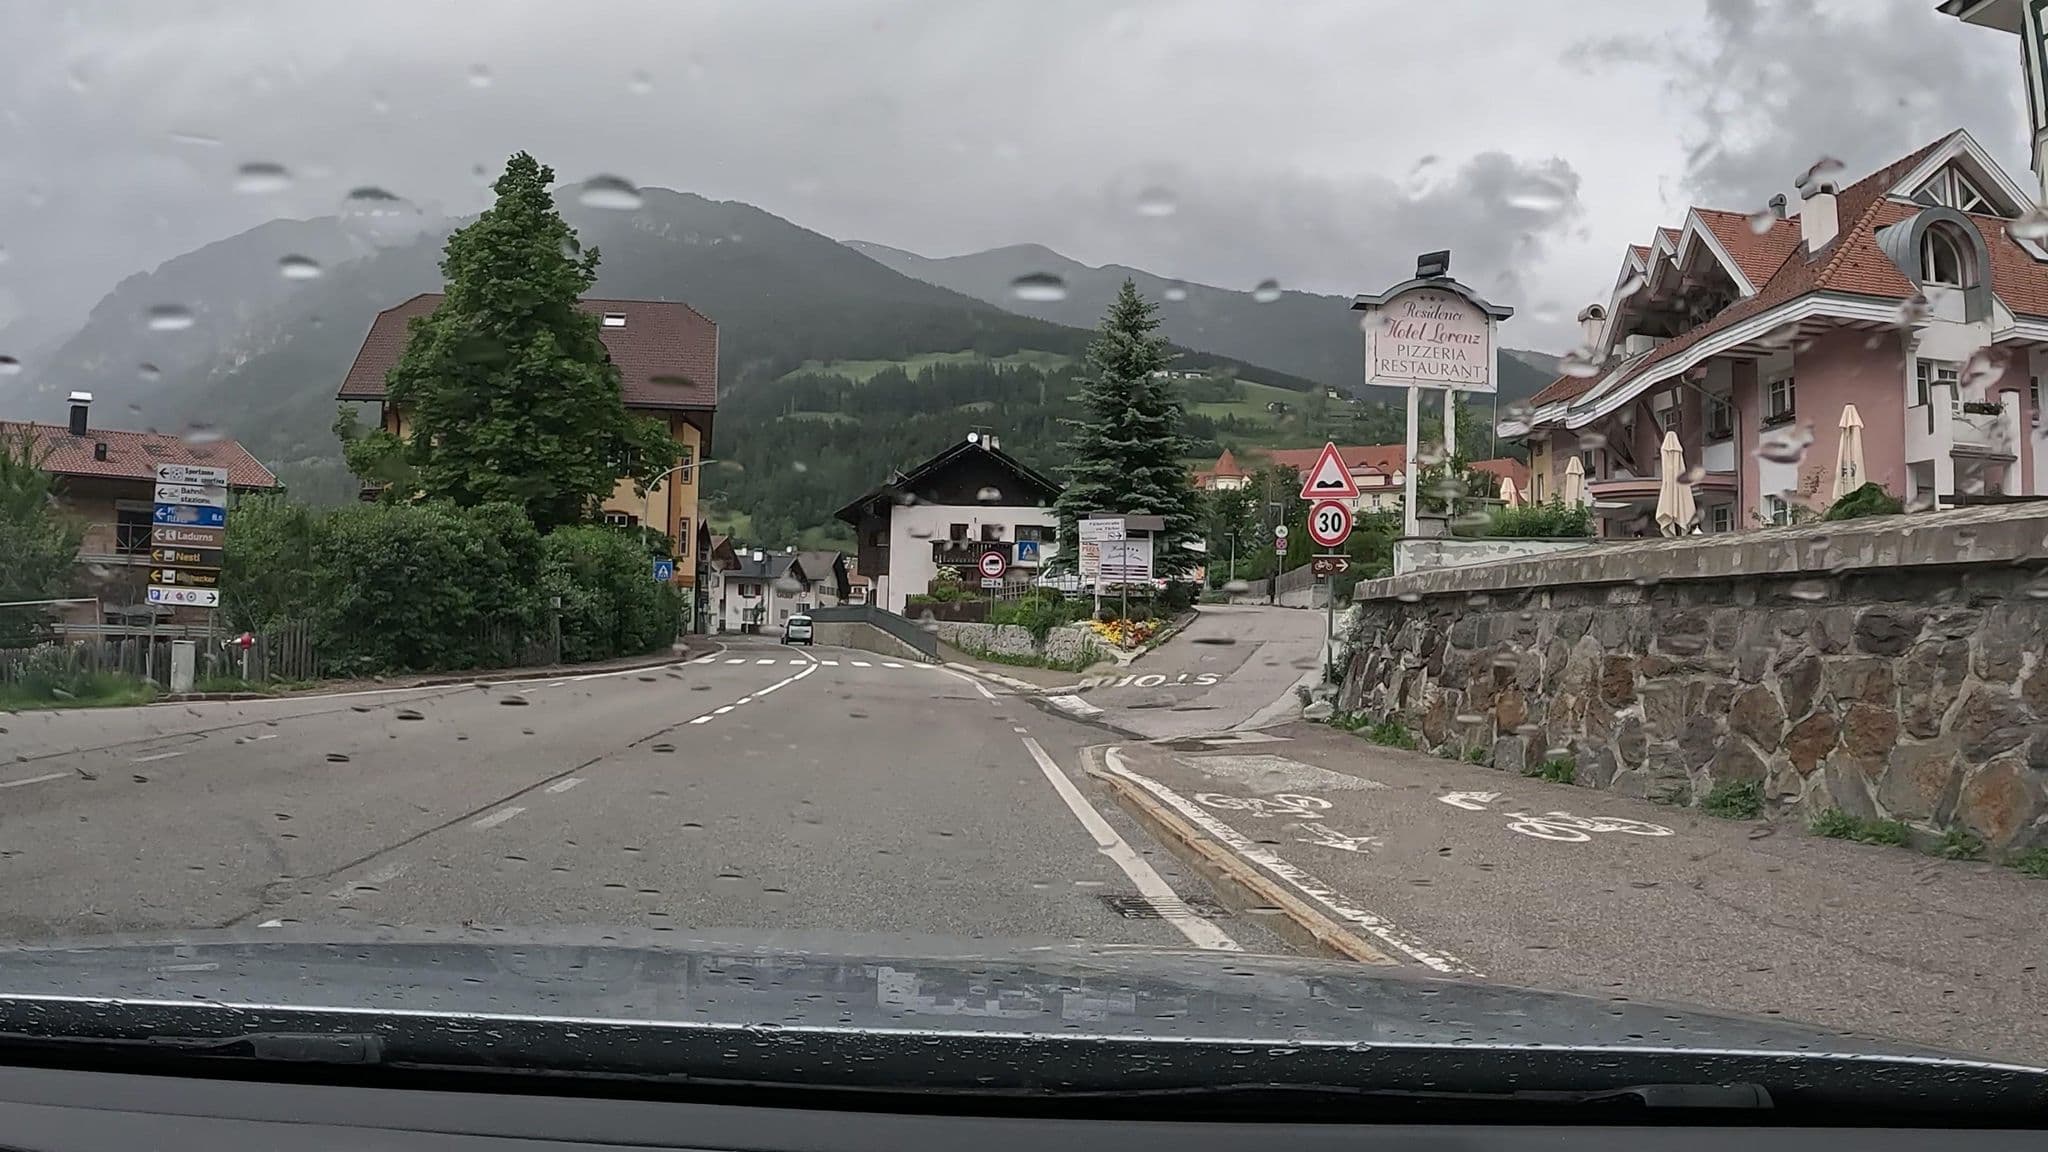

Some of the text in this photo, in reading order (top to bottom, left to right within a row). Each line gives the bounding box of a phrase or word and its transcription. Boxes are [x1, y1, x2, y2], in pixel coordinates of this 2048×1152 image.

[1403, 301, 1465, 320] Residence
[1384, 318, 1480, 344] Hotel Lorenz
[1397, 344, 1466, 361] PIZZERIA
[1381, 359, 1482, 378] RESTAURANT
[1319, 512, 1342, 533] 30
[177, 531, 214, 542] Ladurns
